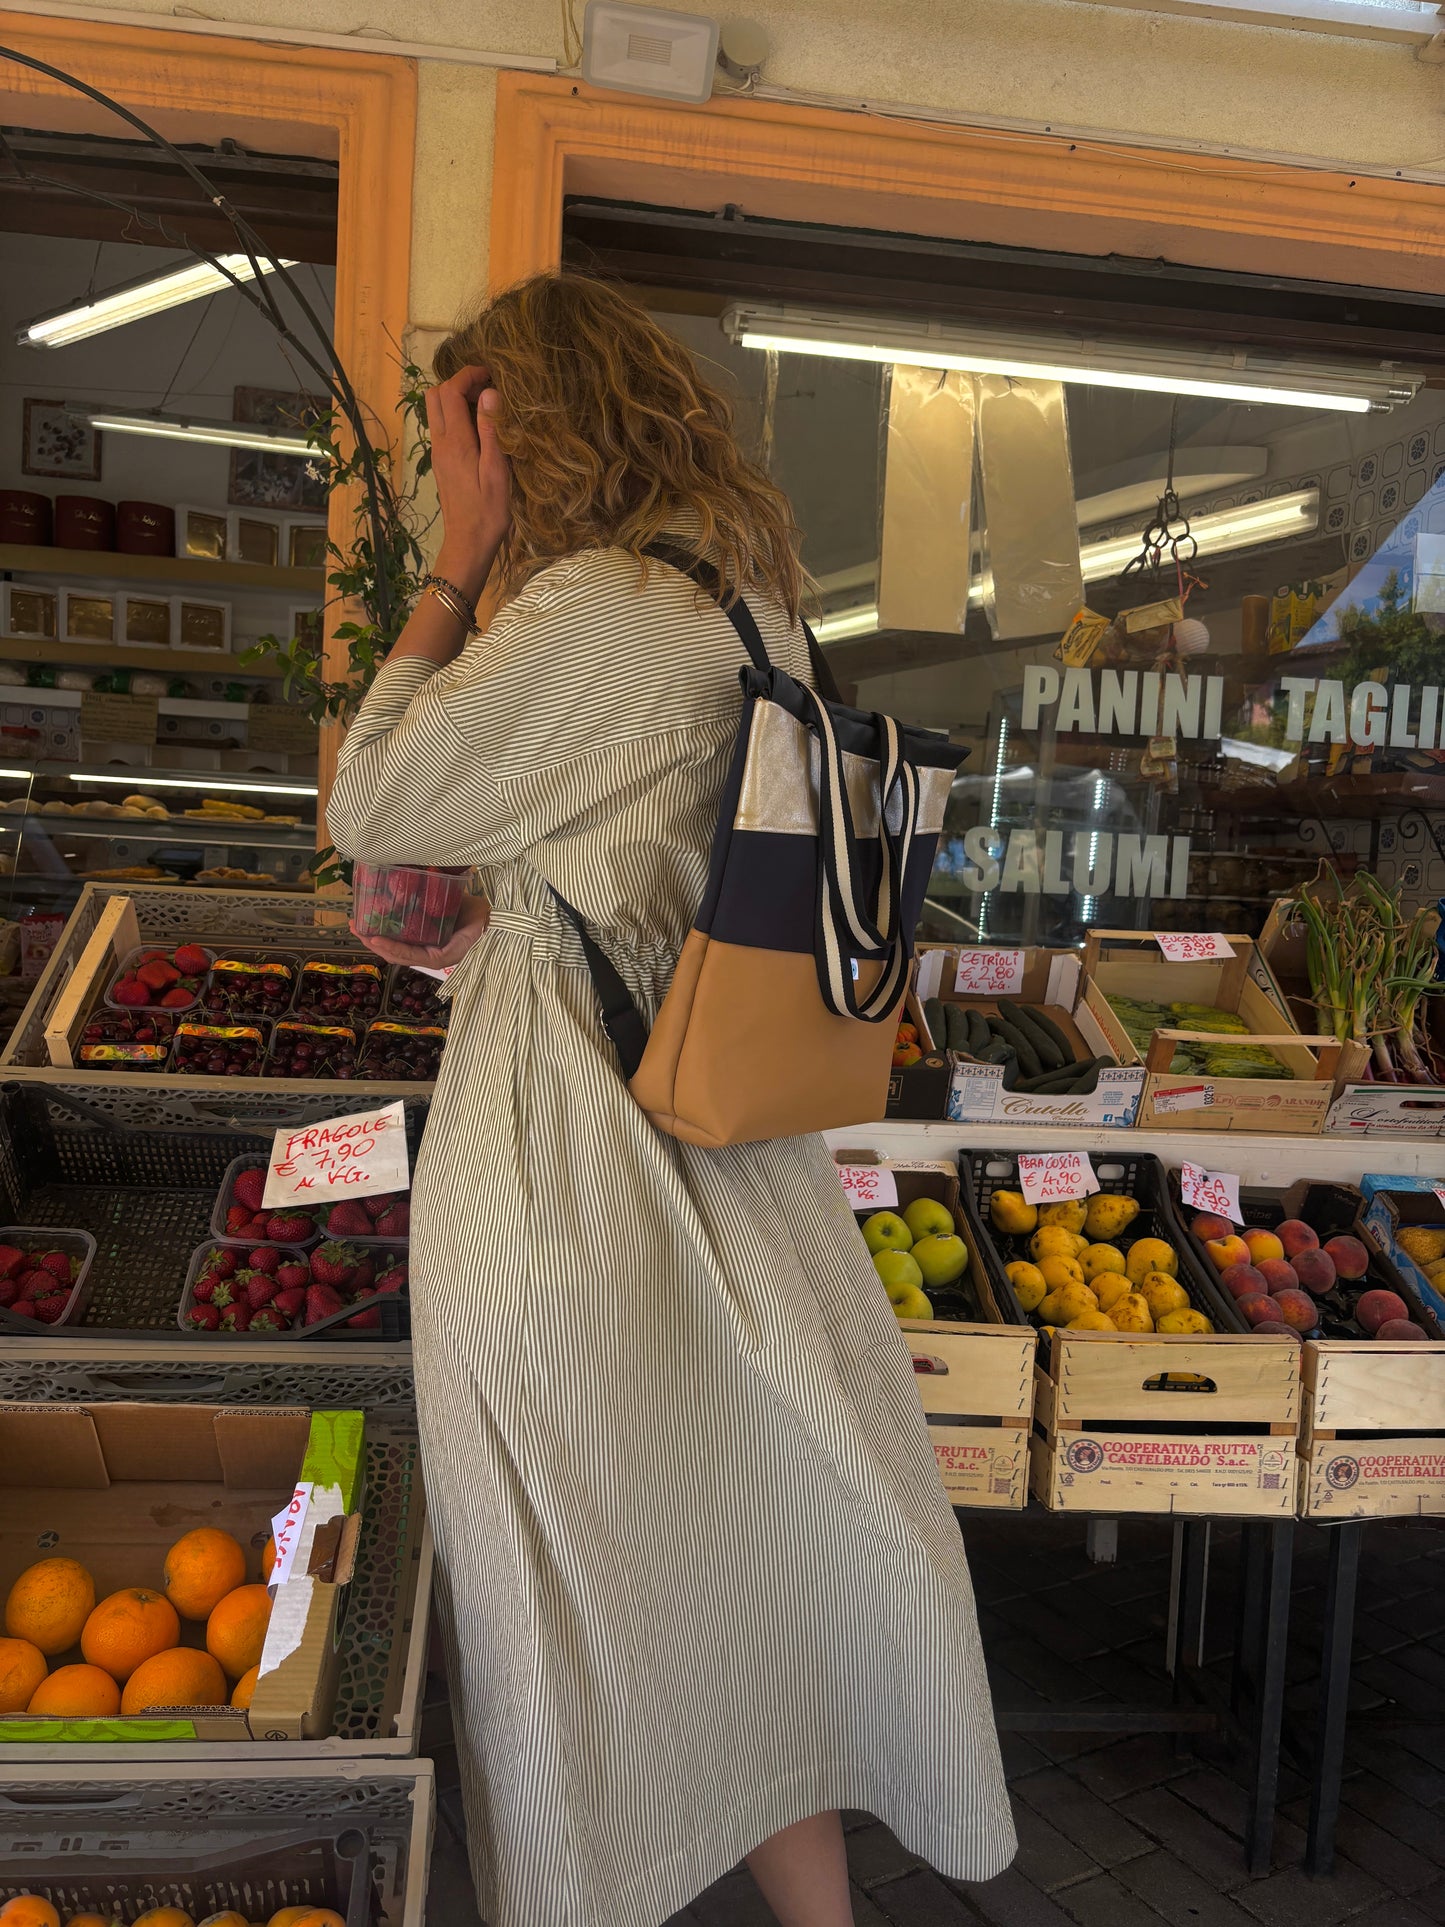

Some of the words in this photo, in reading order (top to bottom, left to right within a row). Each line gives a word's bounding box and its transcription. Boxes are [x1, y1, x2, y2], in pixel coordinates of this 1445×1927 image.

[1021, 665, 1224, 740] PANINI
[1281, 677, 1445, 750] TAGLI
[962, 827, 1191, 899] SALUMI
[1164, 943, 1178, 952] €
[961, 951, 1019, 965] CETRIOLI
[960, 967, 976, 981] €
[978, 966, 1015, 982] 2,80
[967, 981, 980, 989] AL
[1001, 1096, 1090, 1116] Cutello
[286, 1114, 392, 1159] FRAGOLE
[273, 1153, 304, 1177] €
[311, 1138, 375, 1168] 7,90
[1019, 1155, 1045, 1169] PERA
[1046, 1153, 1081, 1170] COSCIA
[843, 1179, 878, 1190] 3,50
[1023, 1174, 1037, 1187] €
[1042, 1170, 1082, 1186] 4,90
[1041, 1187, 1054, 1197] AL
[1182, 1181, 1190, 1192] €
[933, 1446, 988, 1458] FRUTTA
[1102, 1441, 1200, 1455] COOPERATIVA
[1203, 1443, 1257, 1455] FRUTTA
[946, 1458, 979, 1470] S.a.c.
[1108, 1453, 1211, 1466] CASTELBALDO
[1216, 1454, 1249, 1467] S.a.c.
